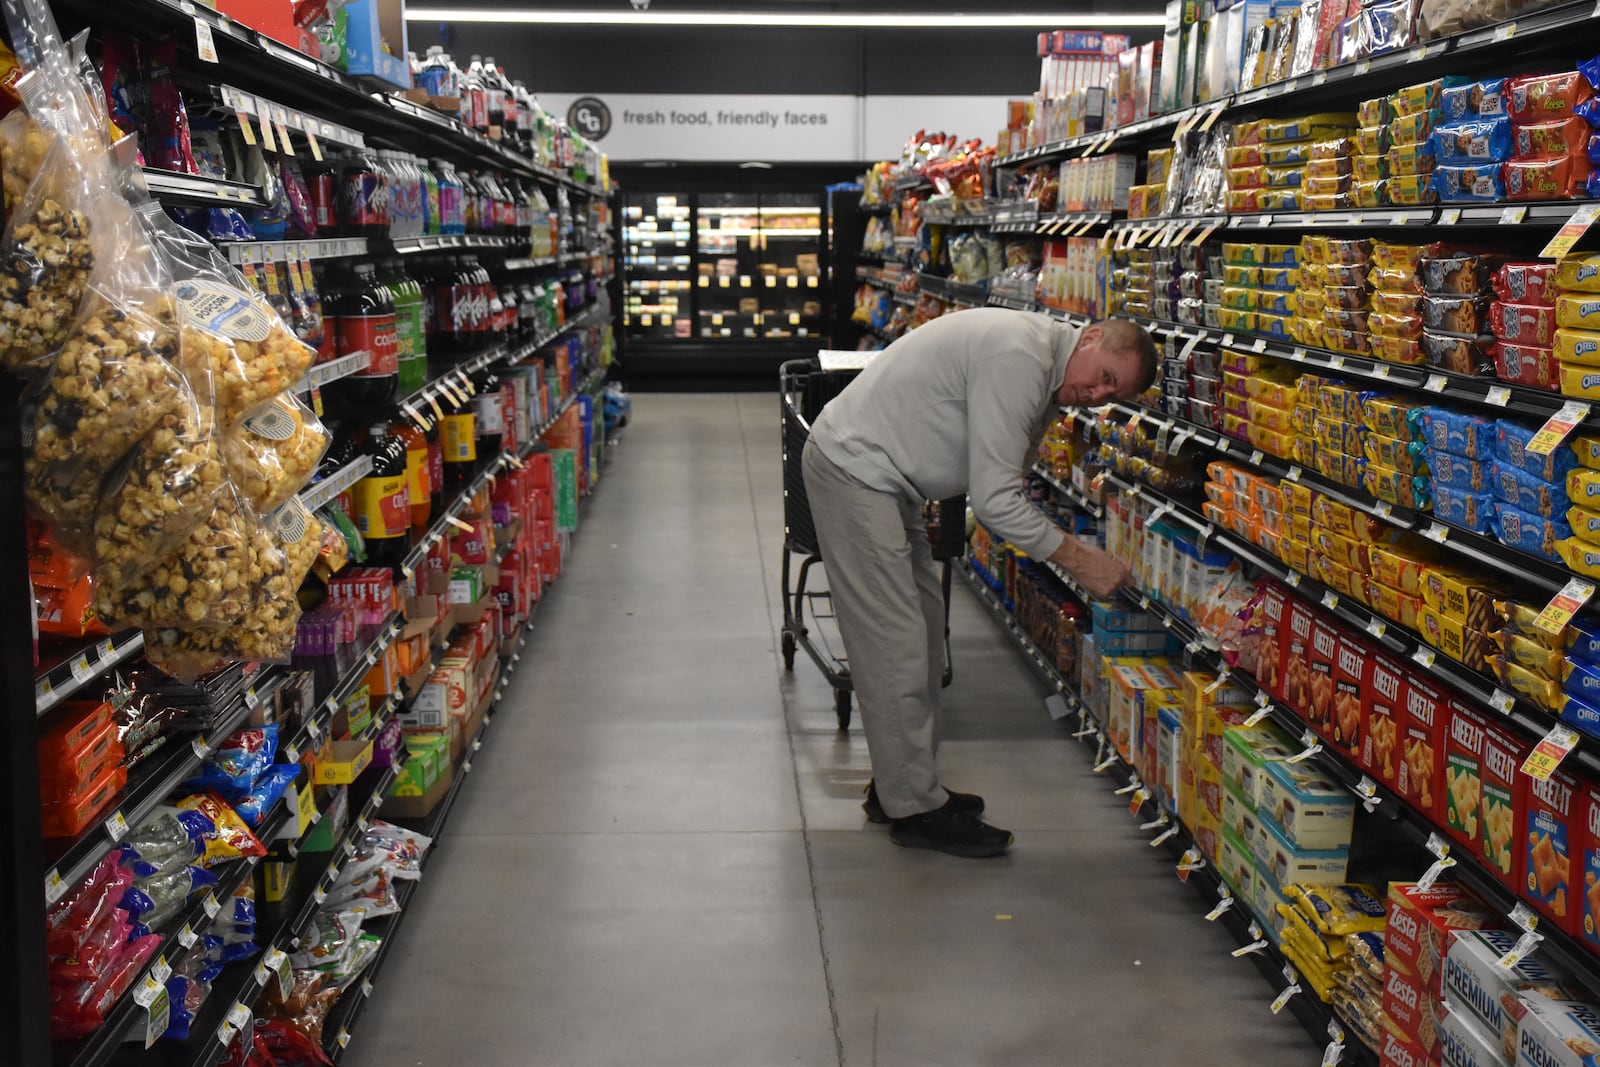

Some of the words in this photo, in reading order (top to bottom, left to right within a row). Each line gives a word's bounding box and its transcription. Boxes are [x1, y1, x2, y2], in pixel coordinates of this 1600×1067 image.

[623, 111, 665, 125] fresh
[670, 111, 712, 127] food,
[717, 111, 778, 128] friendly
[784, 111, 827, 125] faces
[1577, 266, 1598, 281] OREO
[196, 294, 231, 320] POPCORN
[1575, 341, 1597, 355] OREO
[465, 541, 479, 551] 12
[429, 558, 442, 568] 12
[497, 592, 510, 601] 12
[1583, 676, 1600, 688] ORE
[1577, 709, 1600, 722] OREO
[1389, 903, 1417, 941] Zesta
[1387, 970, 1418, 1010] Zesta
[1448, 957, 1501, 1030] PREMIUM
